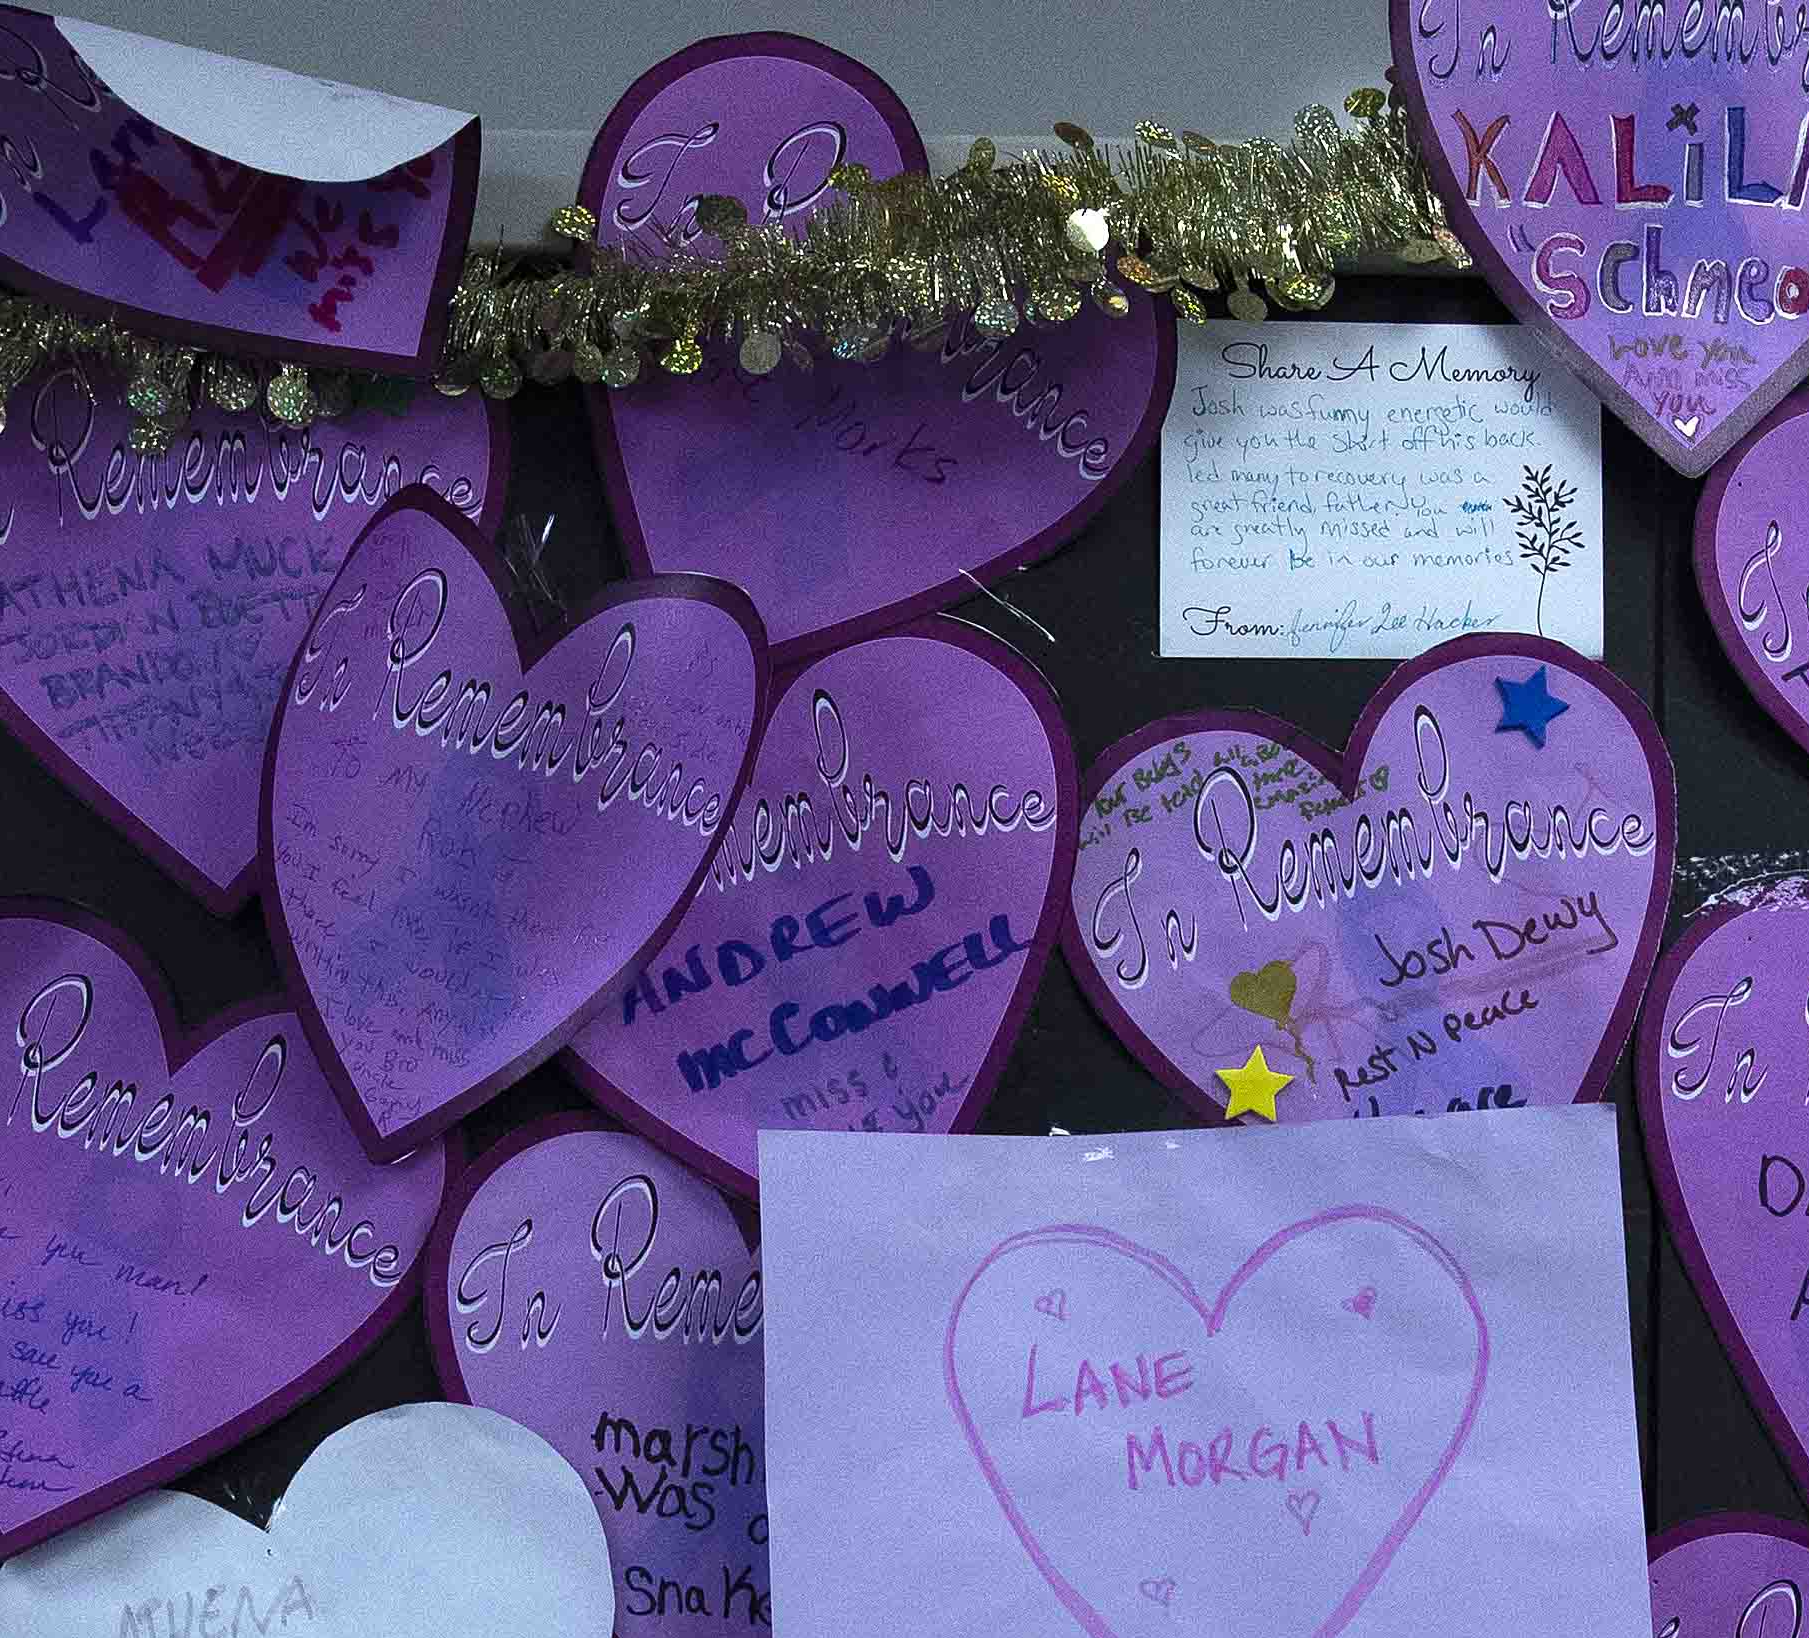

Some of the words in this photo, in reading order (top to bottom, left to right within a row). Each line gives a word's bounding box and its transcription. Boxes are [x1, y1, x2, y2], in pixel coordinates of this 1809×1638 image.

[1221, 342, 1321, 381] Share
[1326, 345, 1379, 381] A
[1389, 345, 1541, 401] Memory
[1182, 605, 1284, 637] From:
[1093, 848, 1197, 990] In
[1193, 703, 1655, 932] Remembrance
[1667, 976, 1769, 1101] In
[8, 973, 403, 1288] Remembrance
[1022, 1345, 1196, 1419] LANE
[1124, 1410, 1380, 1490] MORGAN
